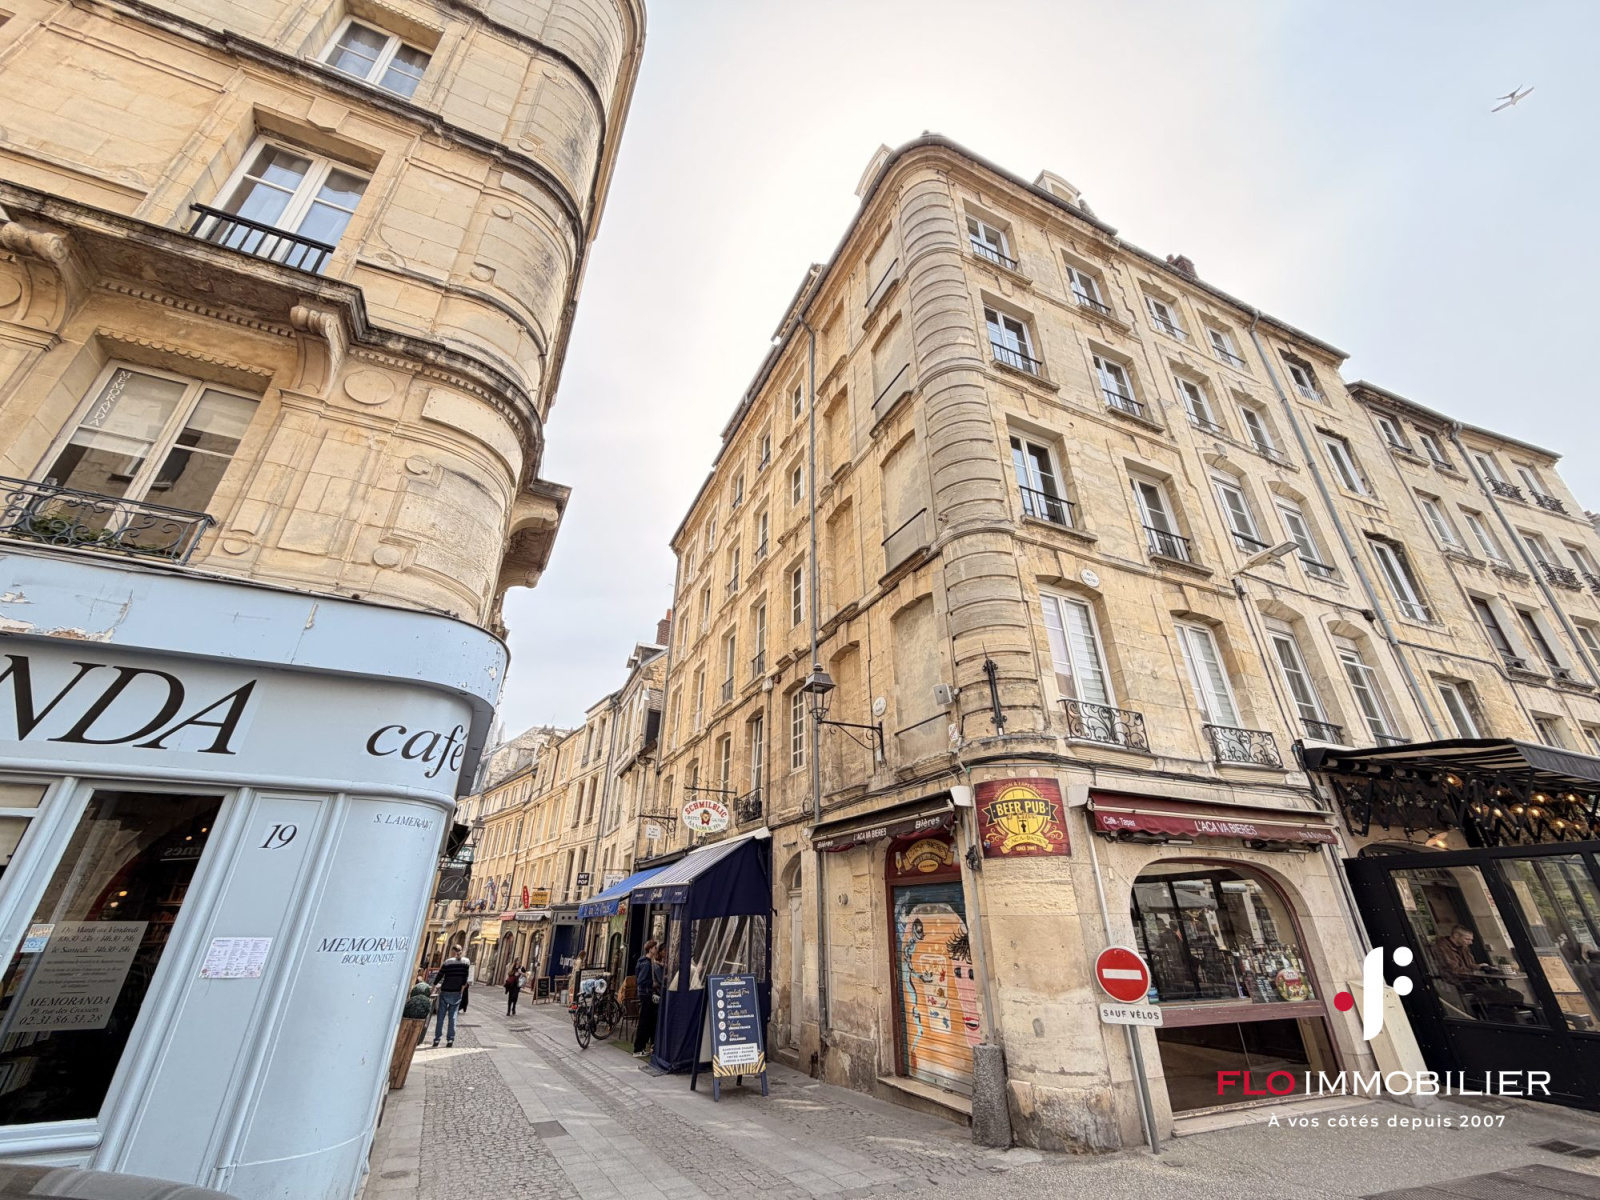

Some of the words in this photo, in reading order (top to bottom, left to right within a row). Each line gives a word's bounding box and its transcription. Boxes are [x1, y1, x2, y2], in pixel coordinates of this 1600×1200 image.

[89, 370, 132, 426] MEMORANDA
[684, 801, 728, 818] SCHMILBLIC
[995, 801, 1022, 816] BEER
[1024, 801, 1046, 814] PUB
[914, 816, 940, 829] Bières
[1119, 817, 1136, 827] Tapas
[1194, 820, 1217, 833] L'ACA
[1216, 822, 1230, 834] VA
[1229, 823, 1258, 836] BIERES
[258, 824, 298, 850] 19
[27, 995, 112, 1007] MEMORANDA
[1103, 1009, 1127, 1018] SAUF
